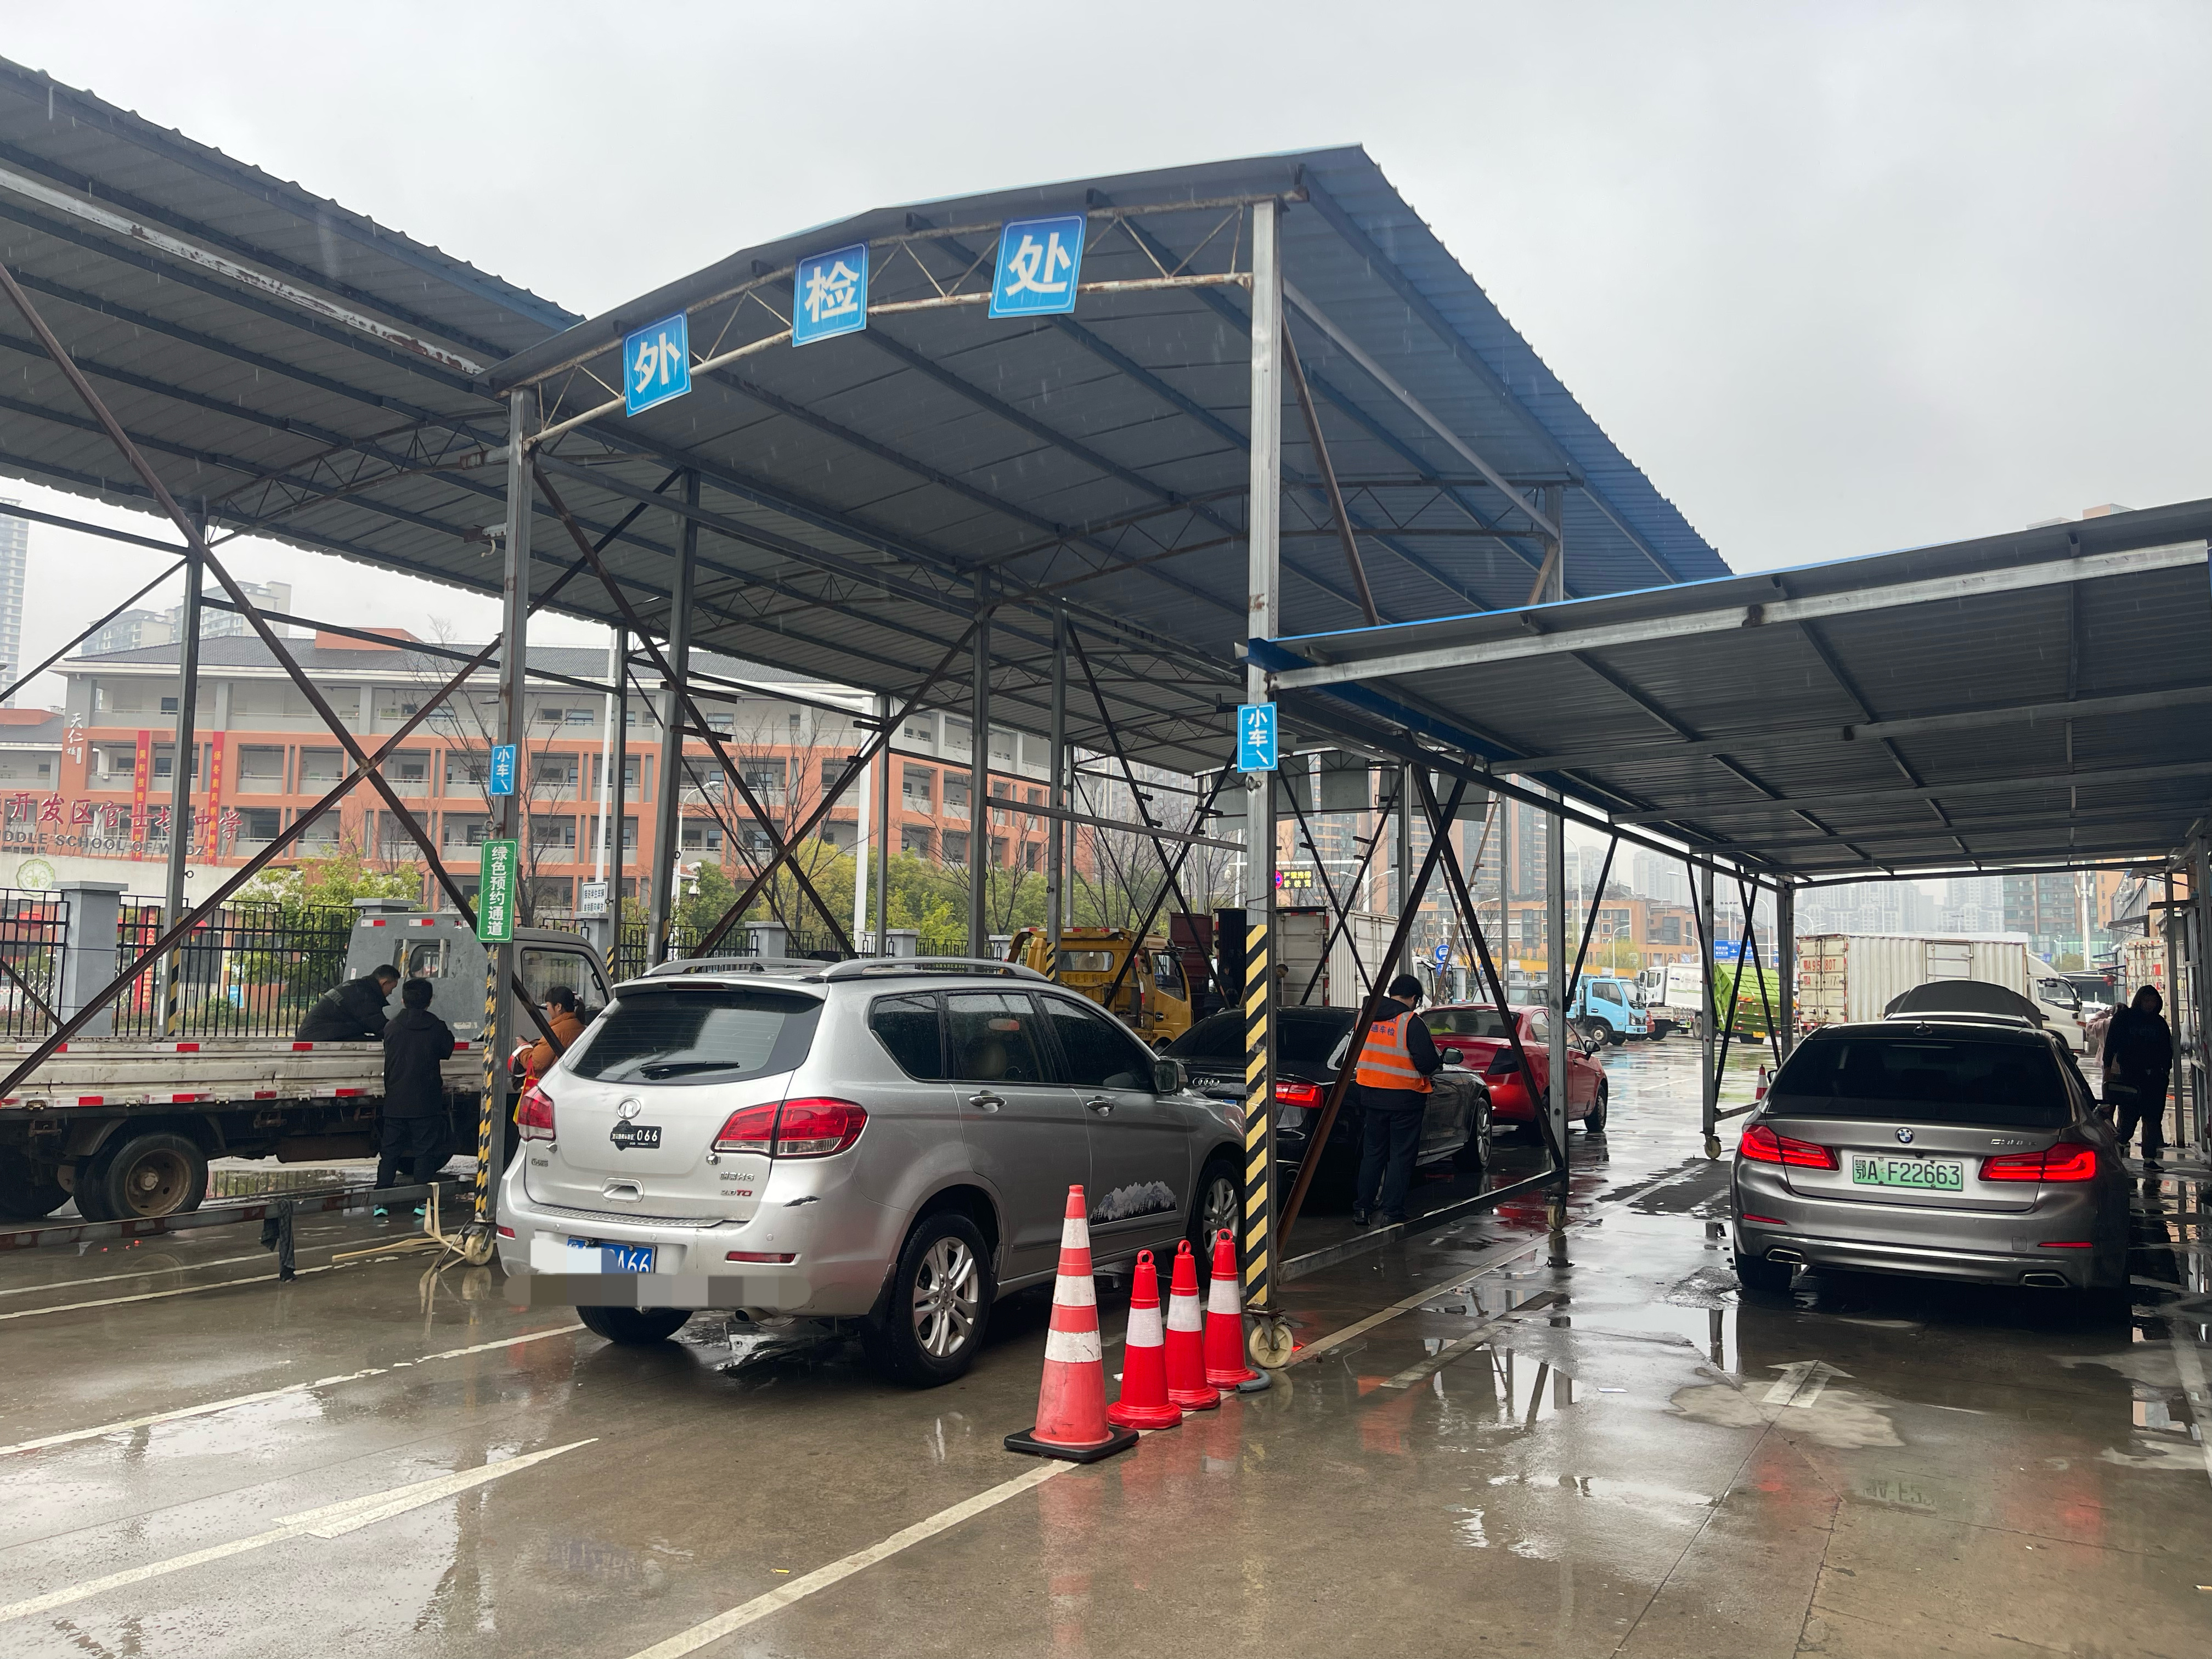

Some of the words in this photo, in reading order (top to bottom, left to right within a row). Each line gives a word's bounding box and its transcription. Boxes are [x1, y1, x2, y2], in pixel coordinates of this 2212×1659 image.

[1248, 709, 1268, 747] 小车
[496, 748, 510, 777] 小车
[0, 793, 242, 840] 开发区官士中学
[0, 830, 48, 844] DDLE
[55, 834, 125, 851] SCHOOL
[132, 840, 153, 853] OF
[159, 842, 205, 856] WDZ
[487, 846, 508, 936] 绿色预约通道
[636, 1130, 658, 1142] 066
